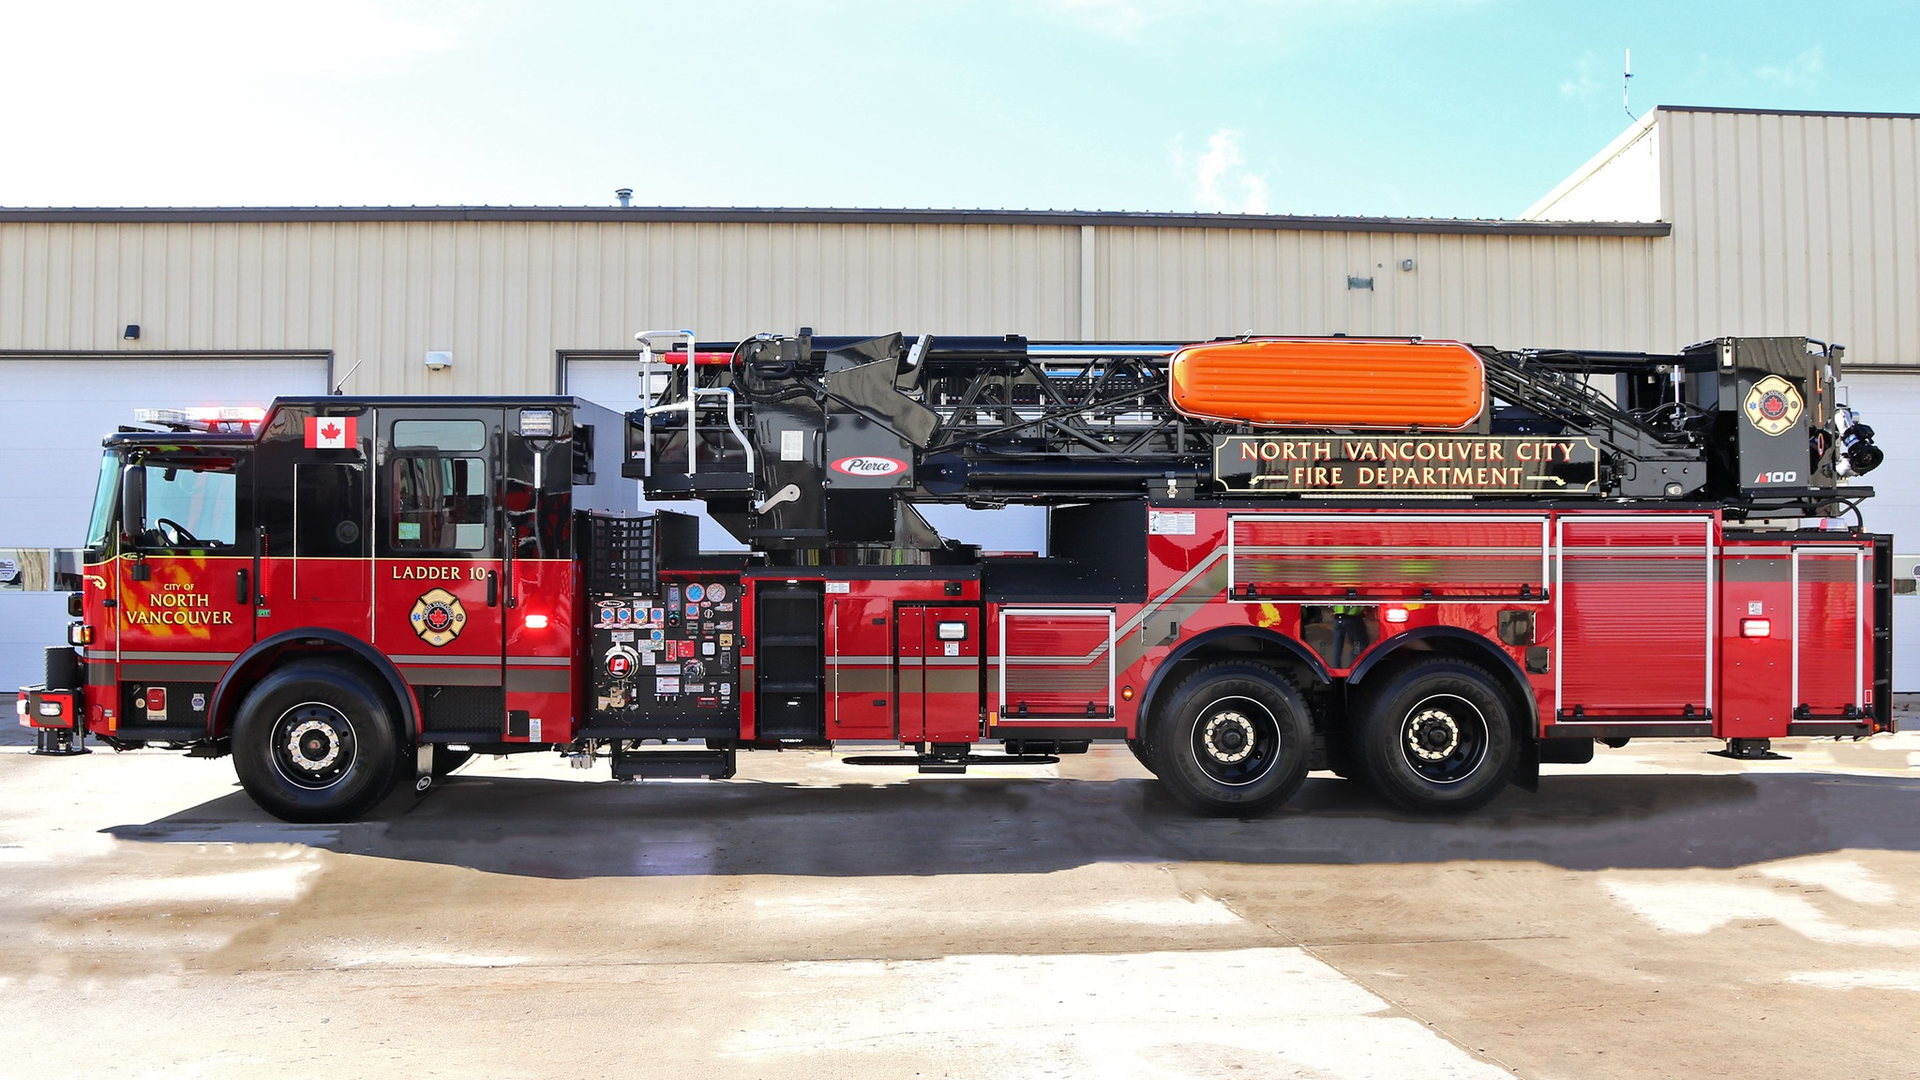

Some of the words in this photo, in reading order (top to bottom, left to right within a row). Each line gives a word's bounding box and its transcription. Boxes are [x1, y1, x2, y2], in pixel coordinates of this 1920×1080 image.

[1239, 441, 1332, 461] NORTH
[1344, 441, 1505, 462] VANCOUVER
[1516, 442, 1576, 462] CITY
[848, 458, 891, 472] Pierce
[1293, 467, 1344, 486] FIRE
[1358, 467, 1523, 487] DEPARTMENT
[392, 565, 462, 580] LADDER
[469, 566, 486, 580] 10
[163, 583, 181, 591] CITY
[183, 583, 195, 591] OF
[150, 593, 209, 607] NORTH
[126, 610, 233, 625] VANCOUVER
[1208, 681, 1297, 751] GOODYEAR
[1434, 679, 1504, 765] GOODYEAR
